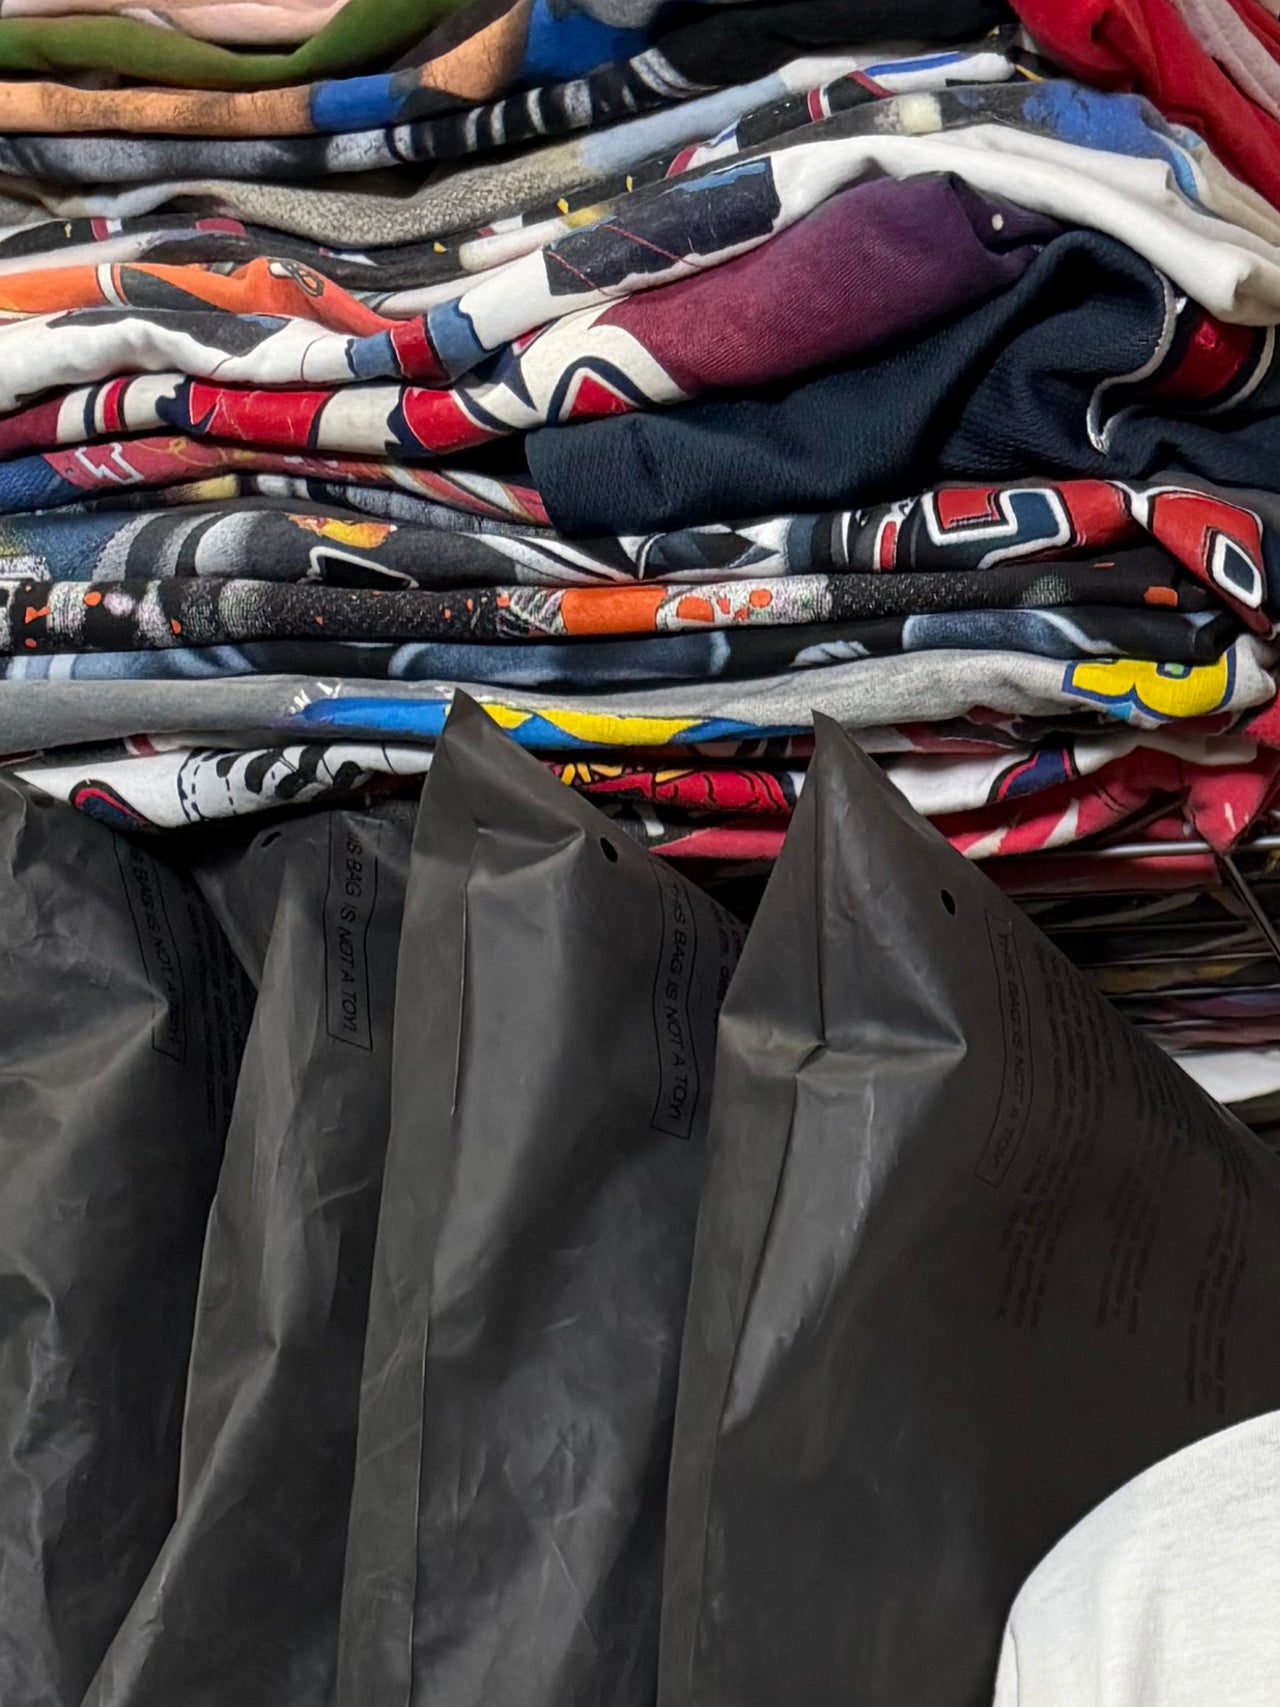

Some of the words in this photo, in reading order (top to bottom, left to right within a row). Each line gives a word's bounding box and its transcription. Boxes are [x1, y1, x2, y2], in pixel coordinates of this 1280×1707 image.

[345, 860, 362, 897] BAG
[340, 903, 358, 923] IS
[338, 926, 355, 971] NOT
[670, 932, 687, 975] BAG
[341, 971, 356, 983] A
[665, 982, 679, 1003] IS
[340, 991, 359, 1034] TOY!
[665, 1006, 685, 1050] NOT
[672, 1051, 686, 1067] A
